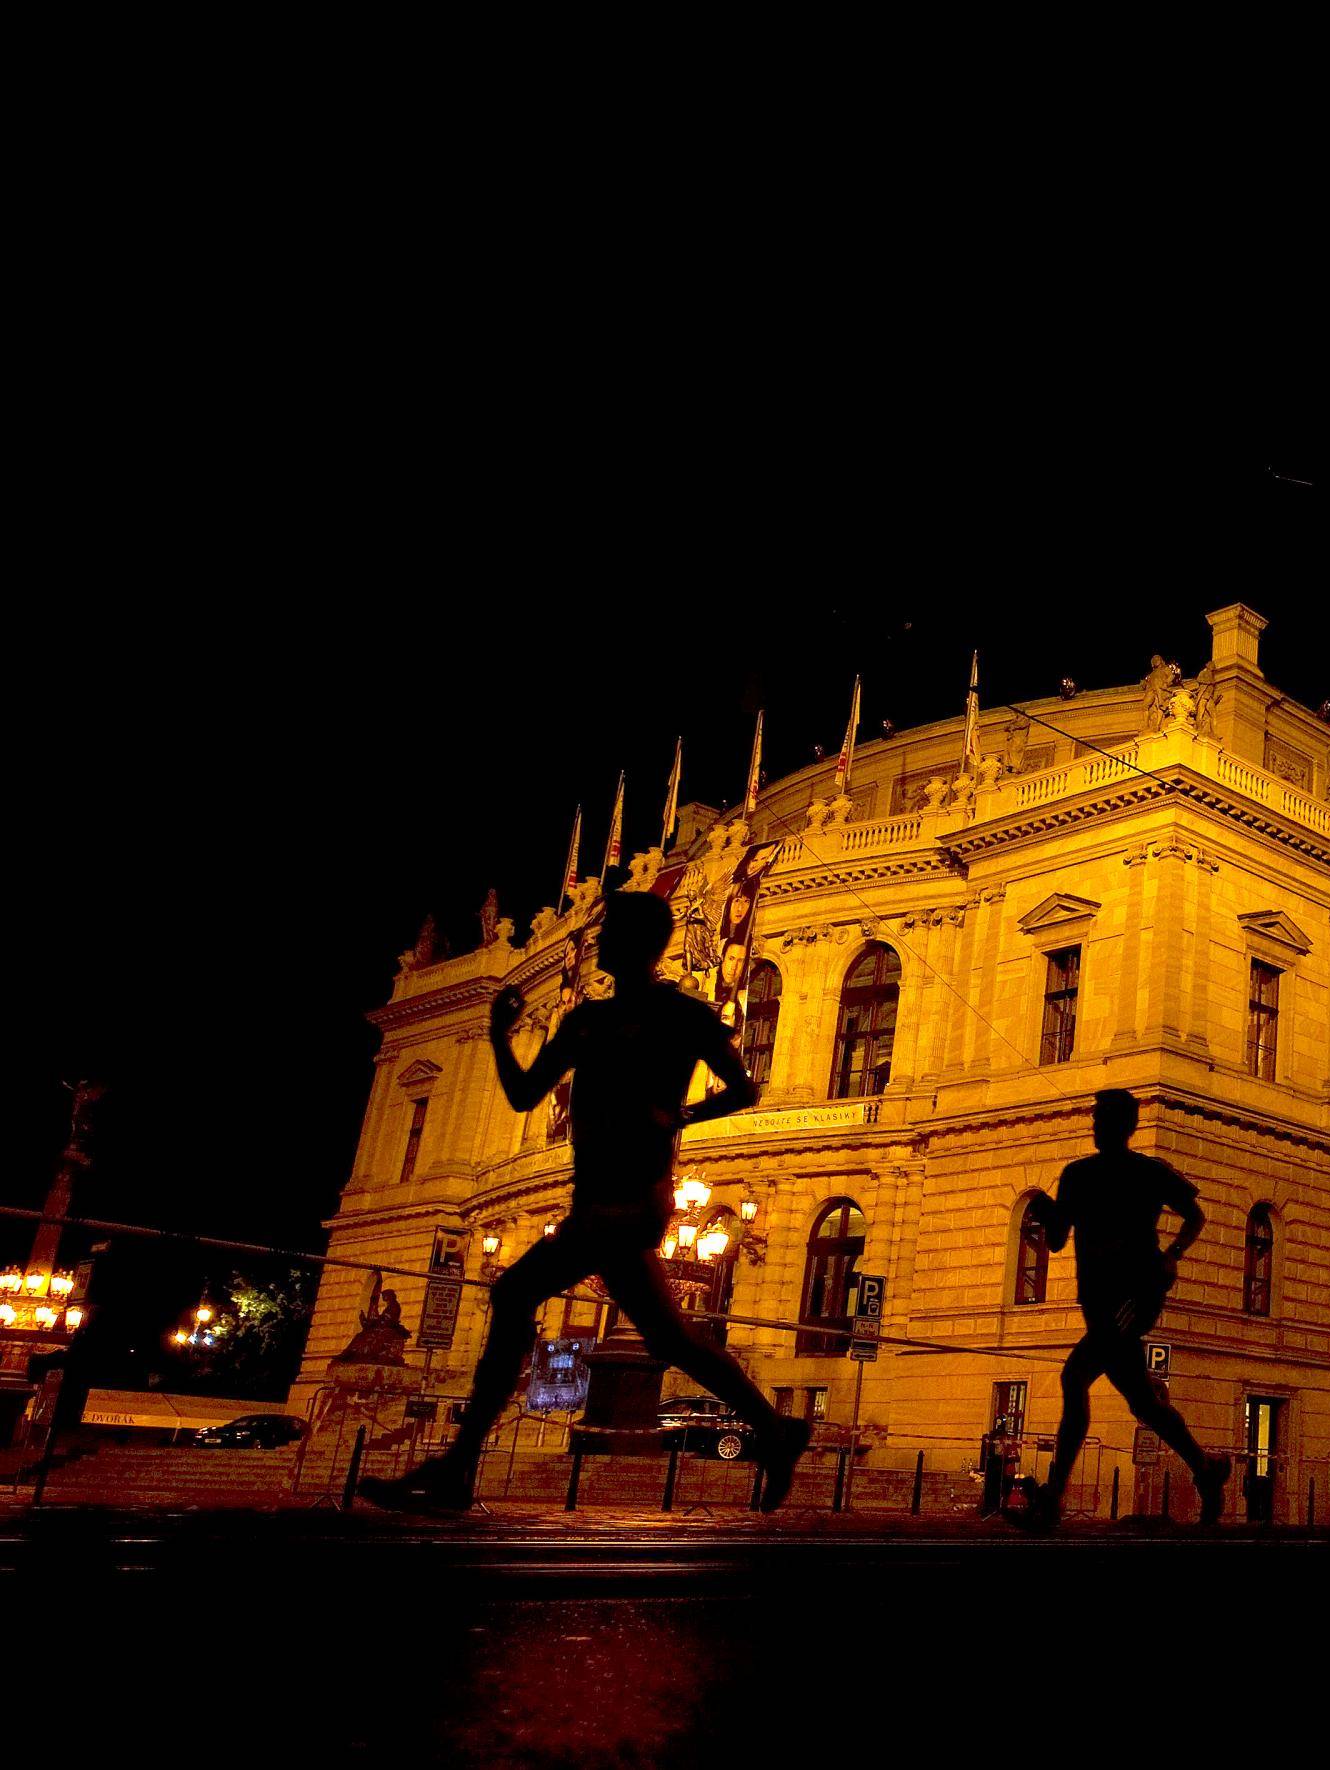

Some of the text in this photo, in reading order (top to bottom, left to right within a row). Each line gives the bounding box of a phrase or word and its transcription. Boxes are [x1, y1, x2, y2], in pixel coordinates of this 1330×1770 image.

[440, 1236, 462, 1263] P
[863, 1280, 880, 1305] P
[1151, 1347, 1166, 1369] P
